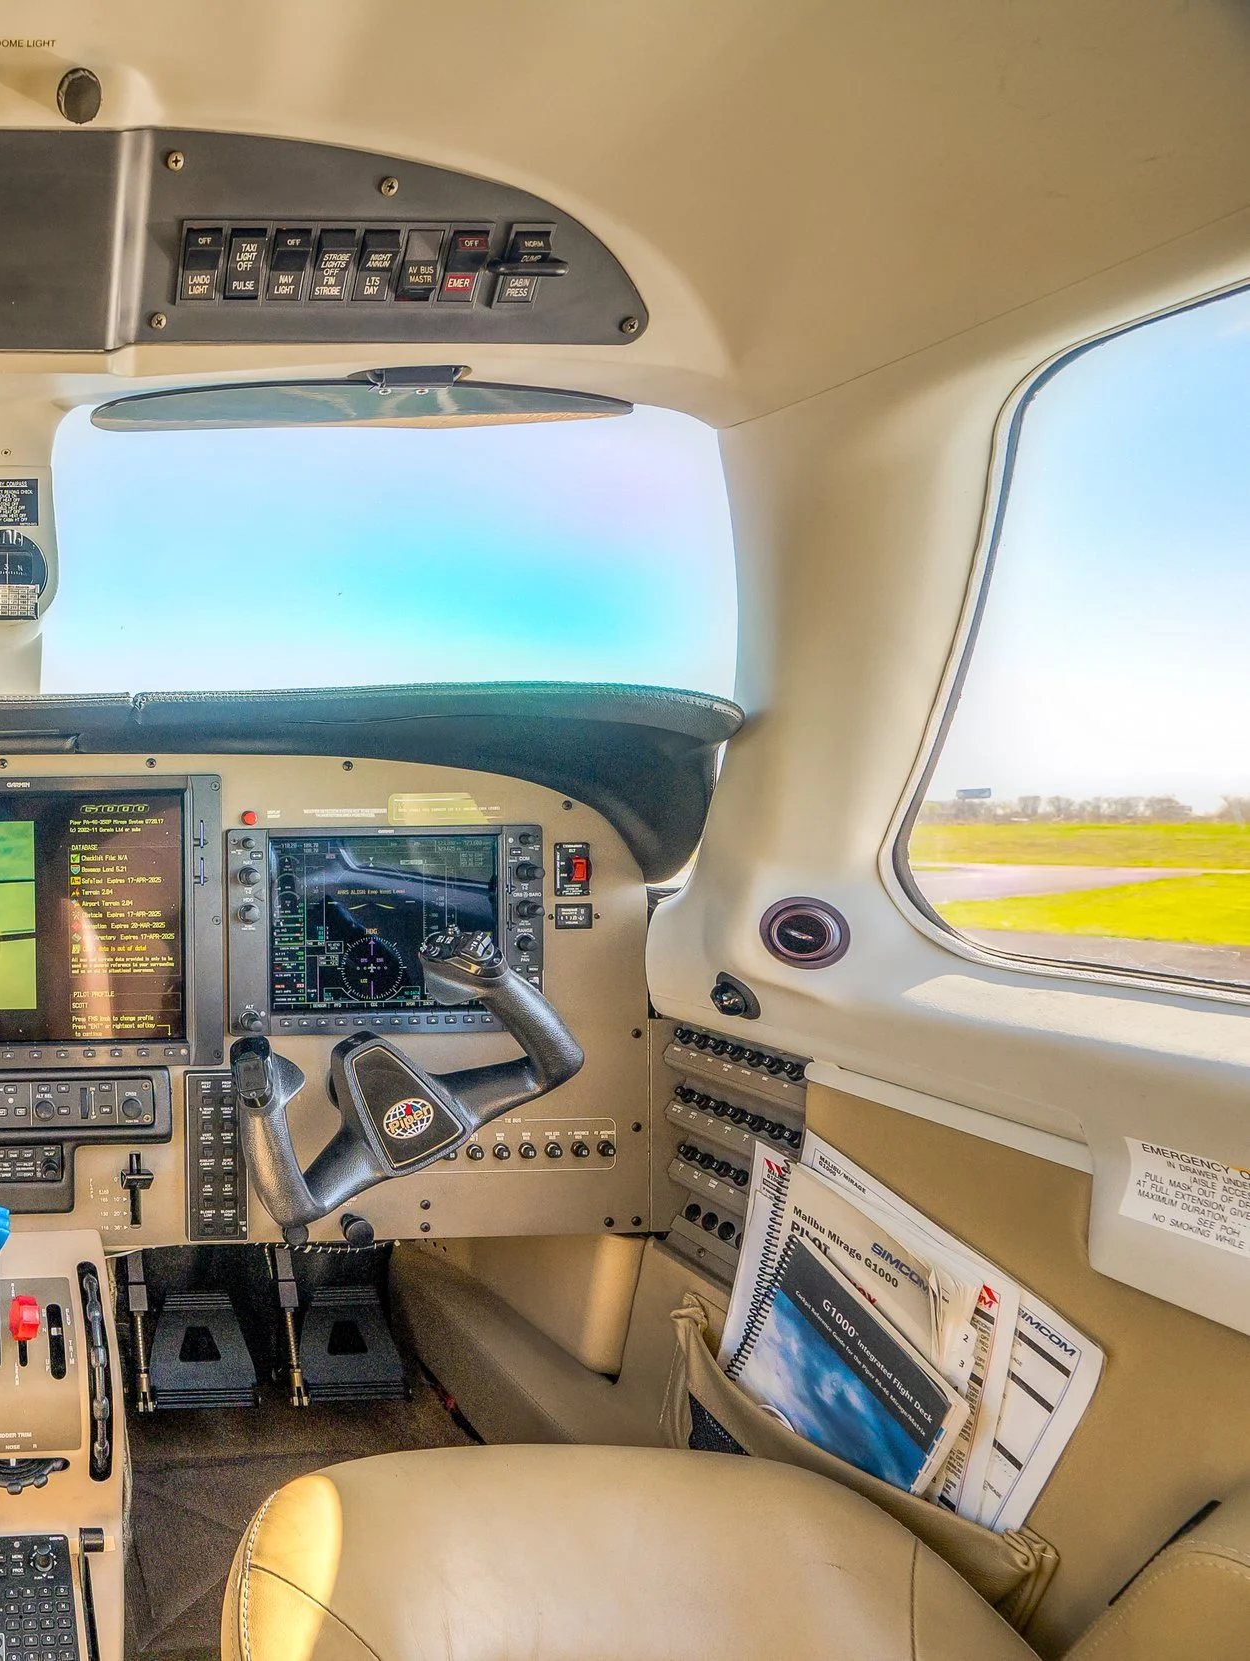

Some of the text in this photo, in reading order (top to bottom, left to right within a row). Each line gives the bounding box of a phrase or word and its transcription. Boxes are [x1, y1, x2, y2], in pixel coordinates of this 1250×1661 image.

[237, 262, 252, 271] OFF
[189, 276, 210, 284] LANDG
[232, 281, 254, 290] PULSE
[279, 275, 294, 284] NAV
[366, 277, 380, 285] LTS
[448, 279, 470, 287] EMER
[189, 286, 208, 294] LIGHT
[274, 286, 294, 294] LIGHT
[314, 287, 341, 295] STROBE
[364, 286, 378, 294] DAY
[388, 1106, 430, 1133] Piper
[1142, 1143, 1230, 1174] EMERGENCY
[819, 1155, 866, 1195] MALIBU/MIRAGE
[1179, 1163, 1218, 1181] DRAWER
[1145, 1172, 1164, 1184] PULL
[1169, 1180, 1192, 1192] MASK
[1198, 1188, 1216, 1198] OUT
[1138, 1190, 1228, 1223] MAXIMUM DURATION
[1150, 1184, 1170, 1196] FULL
[1175, 1193, 1225, 1212] EXTENSION
[1152, 1213, 1245, 1250] NO SMOKING WHILE
[1197, 1218, 1240, 1237] SEE POH
[793, 1206, 898, 1289] Malibu Mirage G1000
[963, 1334, 969, 1342] 2
[832, 1331, 846, 1348] Guide
[862, 1364, 875, 1379] Piper
[858, 1339, 893, 1379] Integrated
[893, 1377, 914, 1403] Flight
[914, 1400, 932, 1423] Deck
